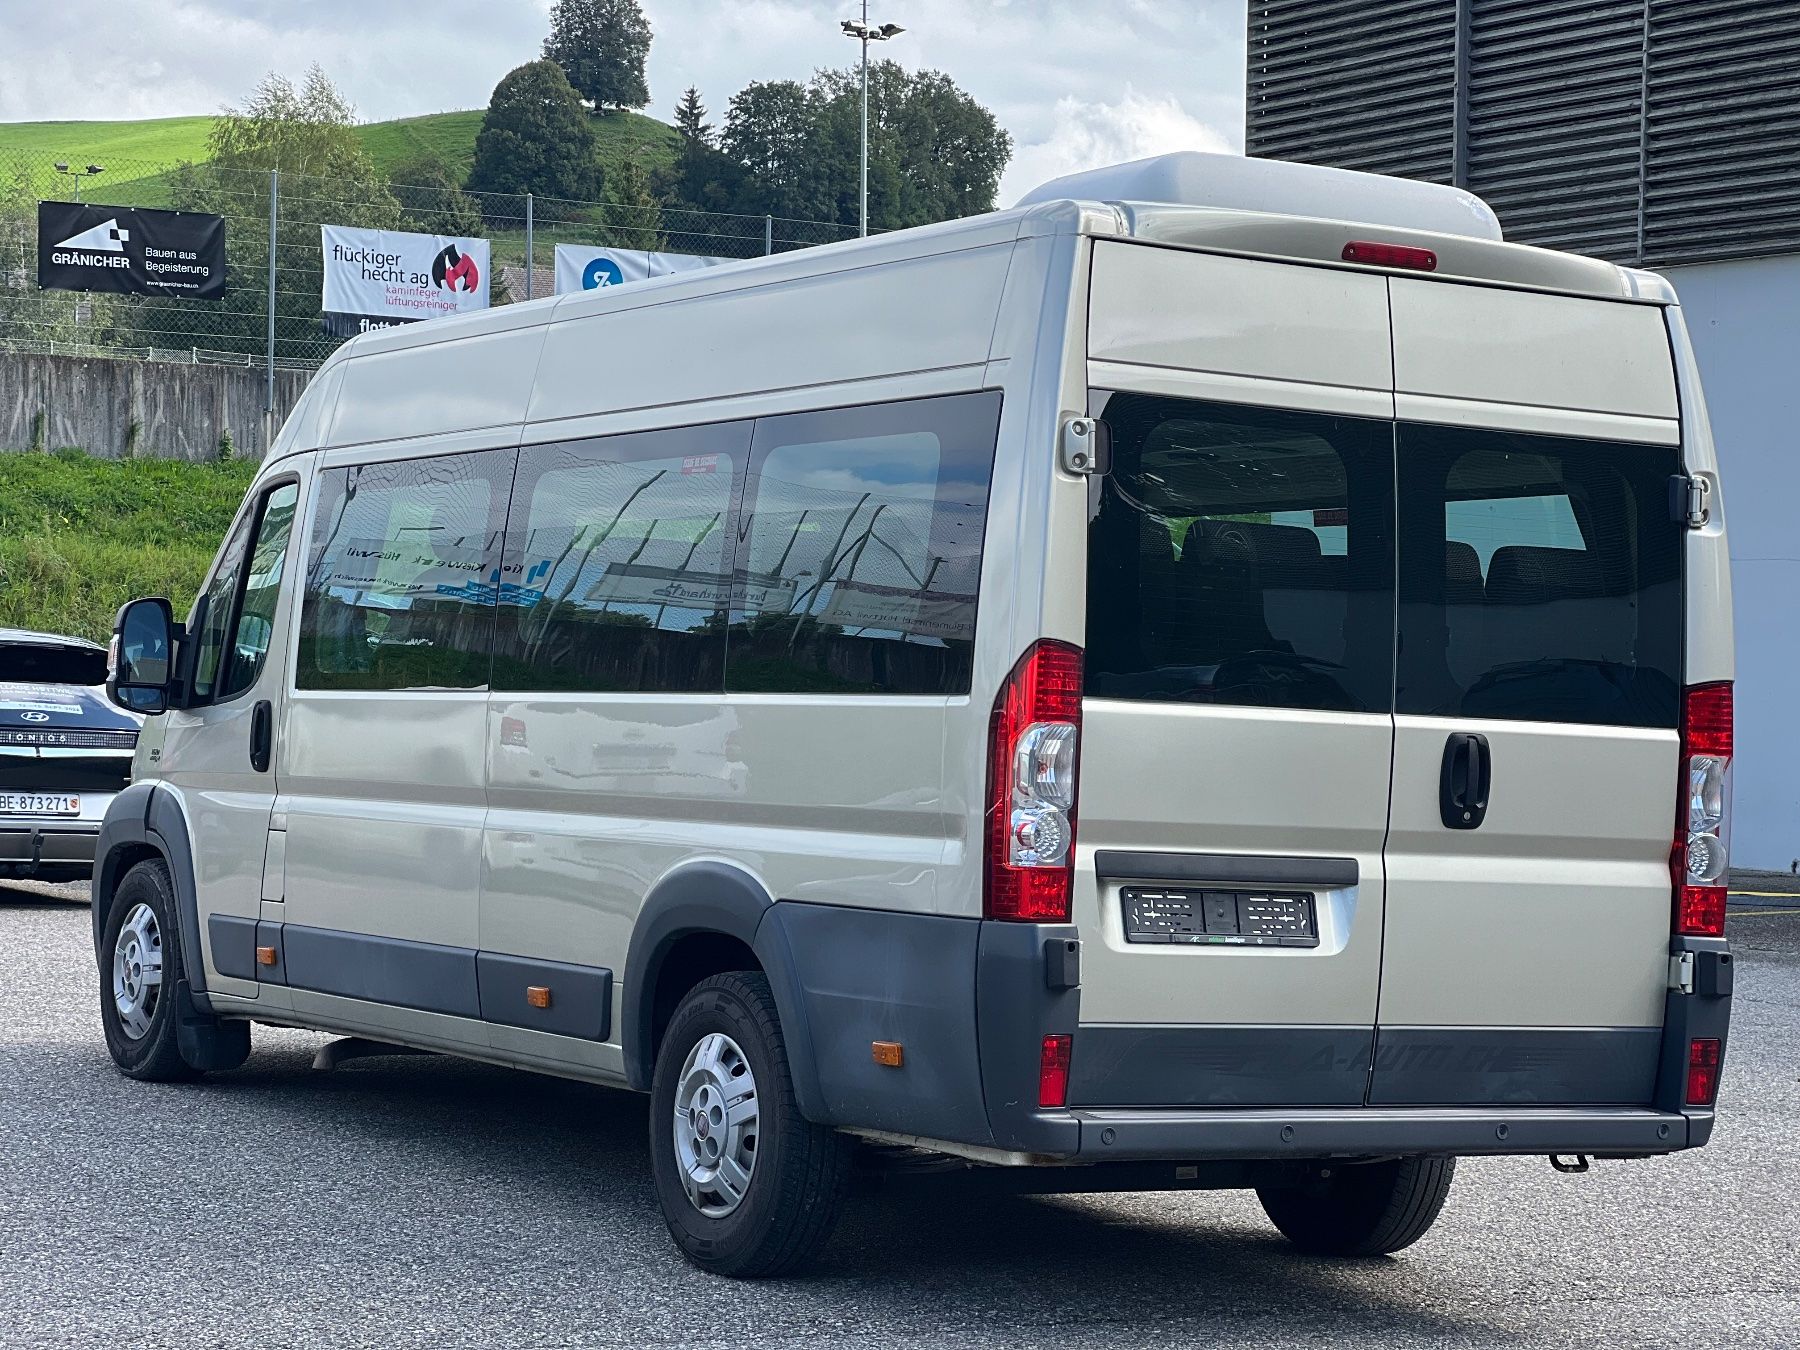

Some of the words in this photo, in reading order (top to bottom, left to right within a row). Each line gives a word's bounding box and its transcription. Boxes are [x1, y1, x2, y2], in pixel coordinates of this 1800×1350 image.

[52, 252, 130, 268] GRÄNICHER
[146, 247, 177, 259] Bauen
[178, 250, 197, 260] aus
[332, 245, 401, 269] flückiger
[145, 260, 209, 276] Begeisterung
[361, 265, 405, 283] hecht
[410, 272, 429, 288] ag
[385, 284, 441, 299] kaminfeger
[385, 296, 458, 311] lüftungsreiniger
